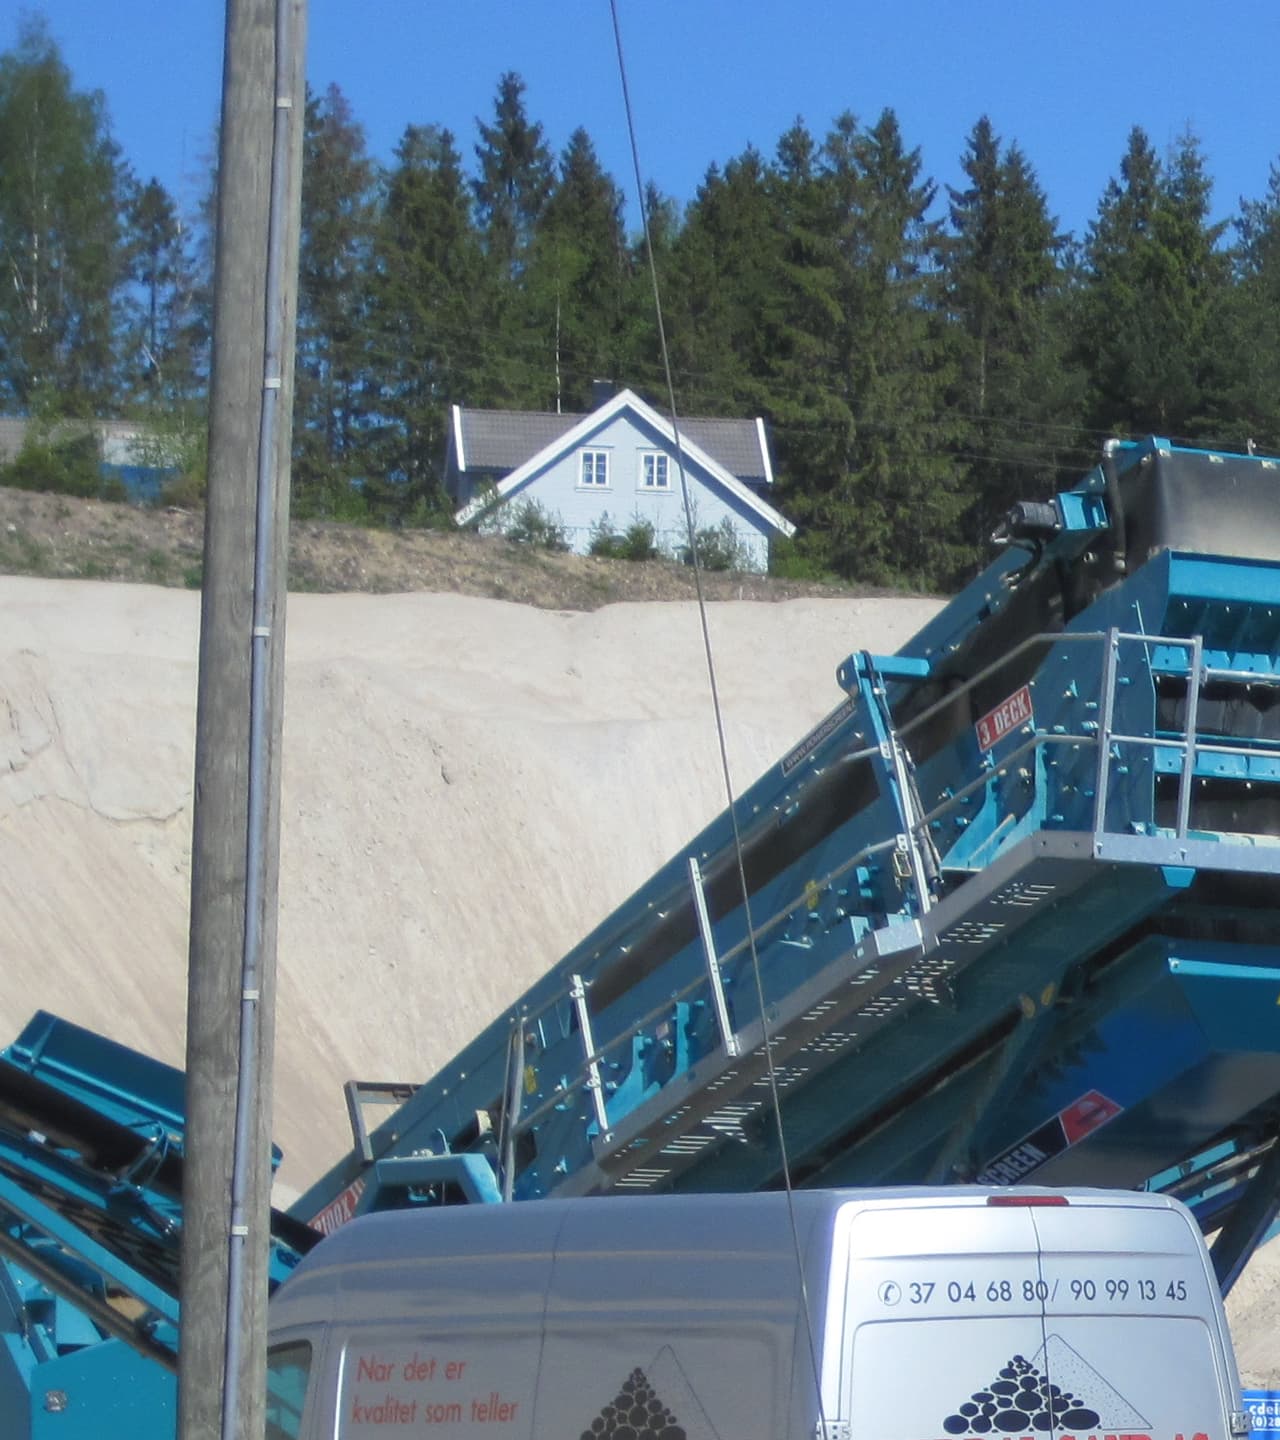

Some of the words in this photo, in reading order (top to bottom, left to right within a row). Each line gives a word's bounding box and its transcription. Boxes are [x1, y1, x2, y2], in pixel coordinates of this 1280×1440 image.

[980, 721, 991, 745] 3
[993, 692, 1029, 736] DECK
[908, 1282, 936, 1304] 37
[947, 1280, 977, 1302] 04
[986, 1280, 1013, 1302] 68
[1070, 1280, 1096, 1301] 90
[1105, 1280, 1129, 1301] 99
[1137, 1280, 1156, 1301] 13
[1165, 1279, 1188, 1301] 45
[403, 1352, 437, 1382] det
[444, 1360, 467, 1381] er
[351, 1392, 418, 1425] kvalitet
[425, 1402, 464, 1424] som
[471, 1391, 520, 1424] teller
